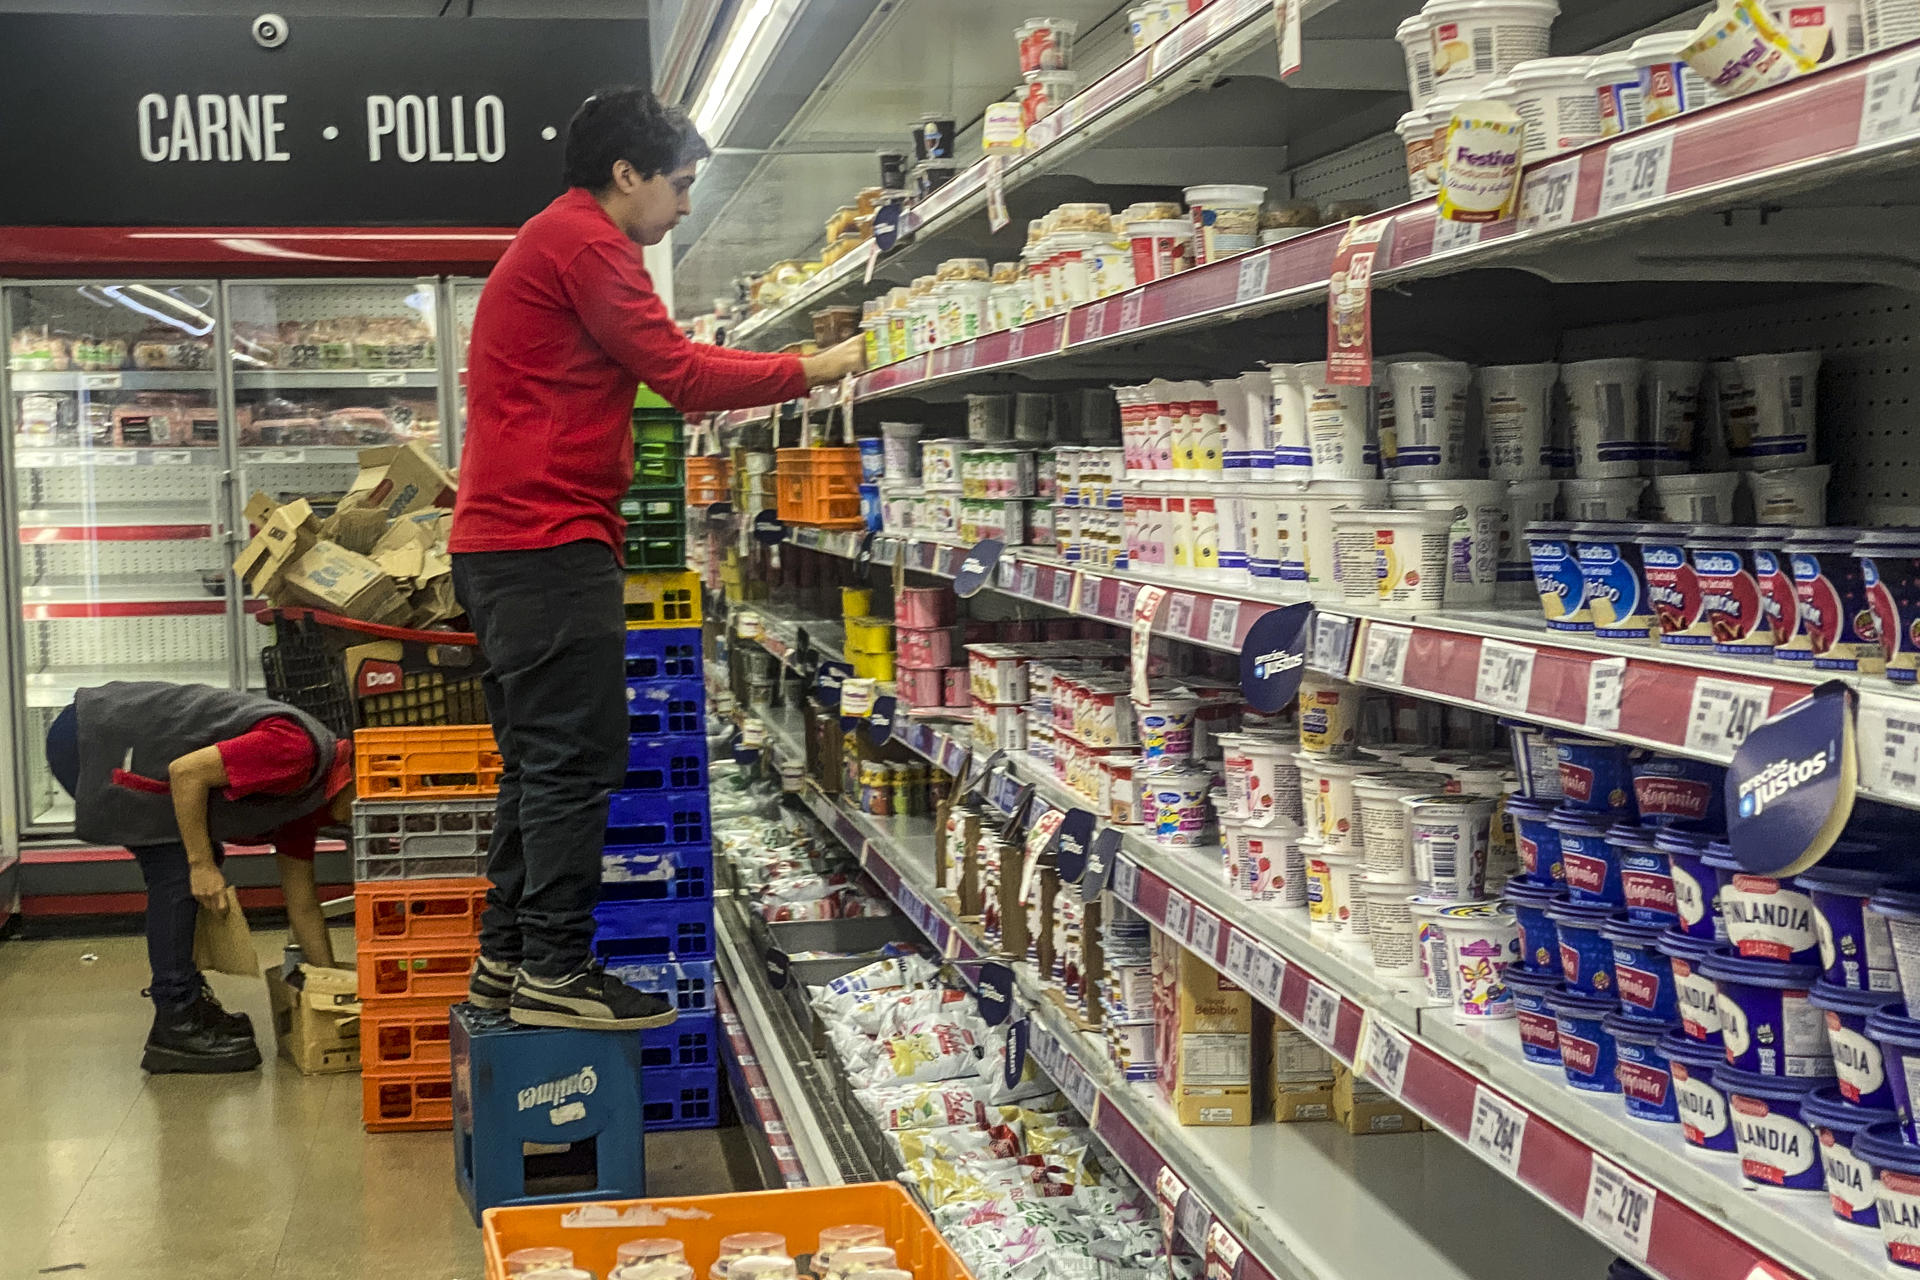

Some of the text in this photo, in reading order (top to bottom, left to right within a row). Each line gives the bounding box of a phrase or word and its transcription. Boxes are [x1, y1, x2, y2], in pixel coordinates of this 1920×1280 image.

[138, 93, 506, 164] CARNE POLLO
[1739, 758, 1789, 799] precios
